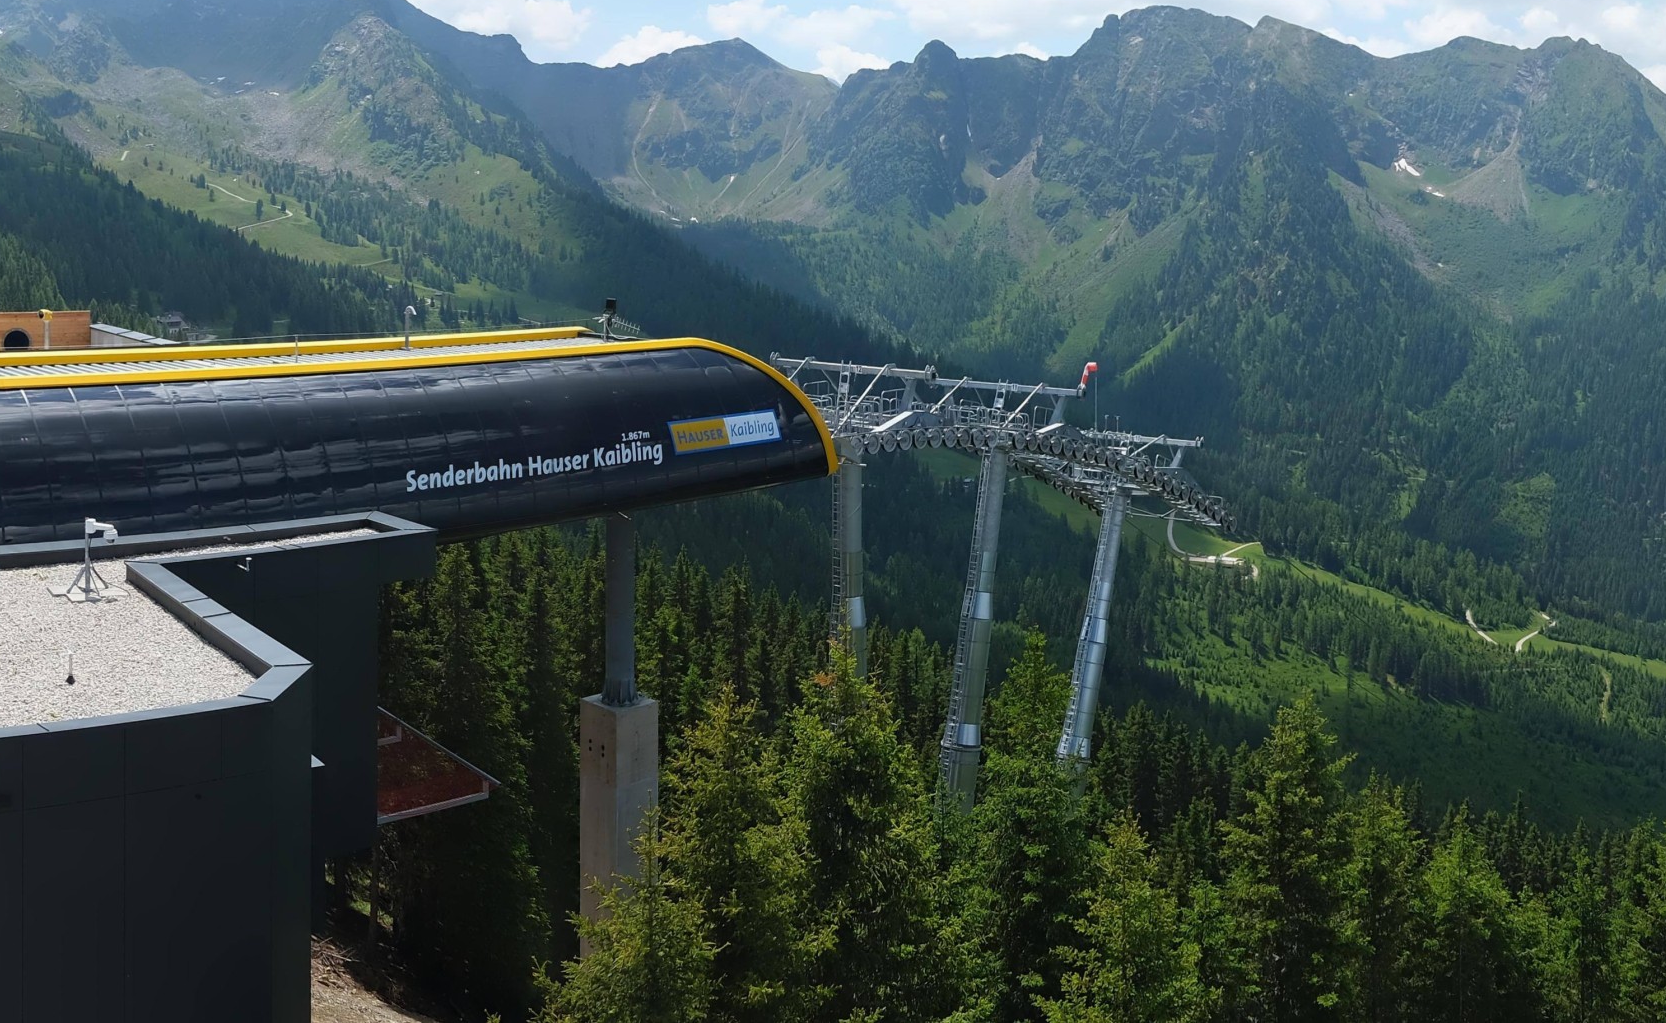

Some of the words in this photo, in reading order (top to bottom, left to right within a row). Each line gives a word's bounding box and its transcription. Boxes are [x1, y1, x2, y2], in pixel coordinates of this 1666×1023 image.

[621, 431, 650, 441] 1.867m
[676, 427, 724, 446] HAUSER
[730, 417, 775, 437] Kaibling
[406, 458, 523, 492] Senderbahn
[528, 451, 590, 477] Hauser
[593, 440, 663, 468] Kaibling
